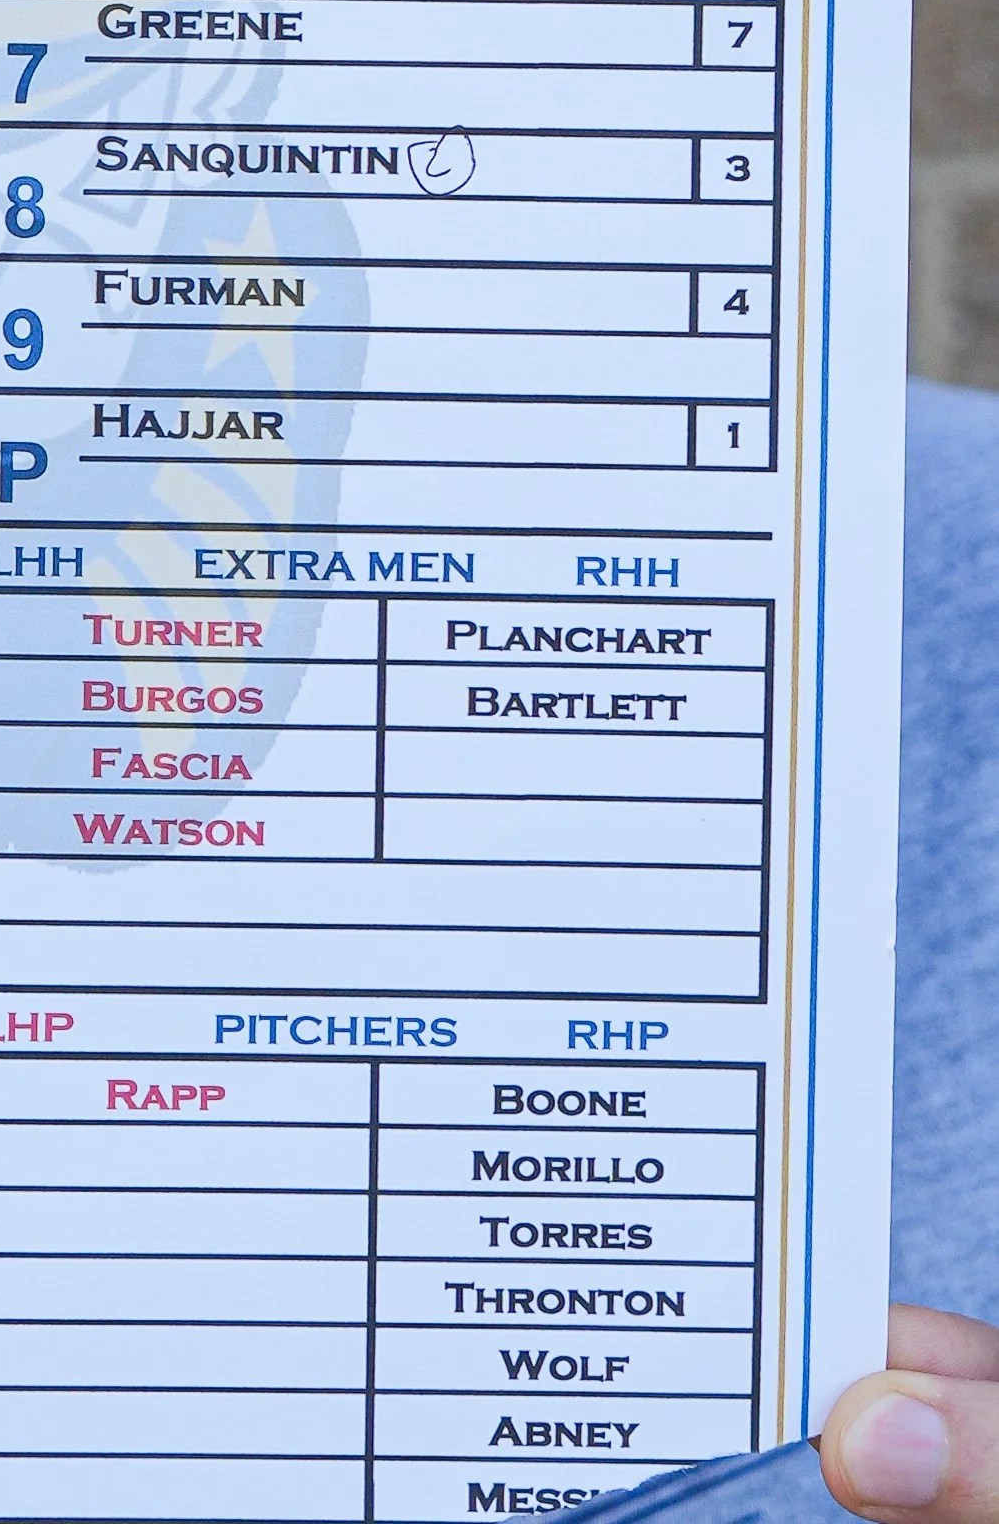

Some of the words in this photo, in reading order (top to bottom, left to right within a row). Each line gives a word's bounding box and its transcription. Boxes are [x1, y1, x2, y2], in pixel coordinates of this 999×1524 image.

[97, 3, 303, 43] GREENE
[727, 20, 753, 49] 7
[7, 42, 48, 104] 7
[95, 135, 399, 178] SANQUINTIN
[725, 154, 751, 182] 3
[4, 175, 46, 239] 8
[95, 268, 306, 307] FURMAN
[723, 288, 750, 316] 4
[2, 308, 44, 371] 9
[92, 403, 284, 440] HAJJAR
[727, 422, 740, 449] 1
[0, 441, 48, 504] P
[194, 548, 356, 582] EXTRA
[368, 551, 474, 583] MEN
[576, 556, 679, 588] RHH
[82, 613, 263, 648] TURNER
[446, 619, 712, 655] PLANCHART
[82, 680, 264, 715] BURGOS
[467, 686, 688, 721] BARTLETT
[92, 747, 253, 781] FASCIA
[73, 813, 265, 847] WATSON
[215, 1014, 458, 1048] PITCHERS
[567, 1019, 669, 1051] RHP
[107, 1079, 226, 1111] RAPP
[492, 1084, 647, 1118] BOONE
[471, 1150, 665, 1184] MORILLO
[479, 1215, 653, 1251] TORRES
[444, 1281, 685, 1317] THRONTON
[499, 1349, 630, 1383] WOLF
[488, 1416, 639, 1449] ABNEY
[467, 1482, 599, 1516] MESS
